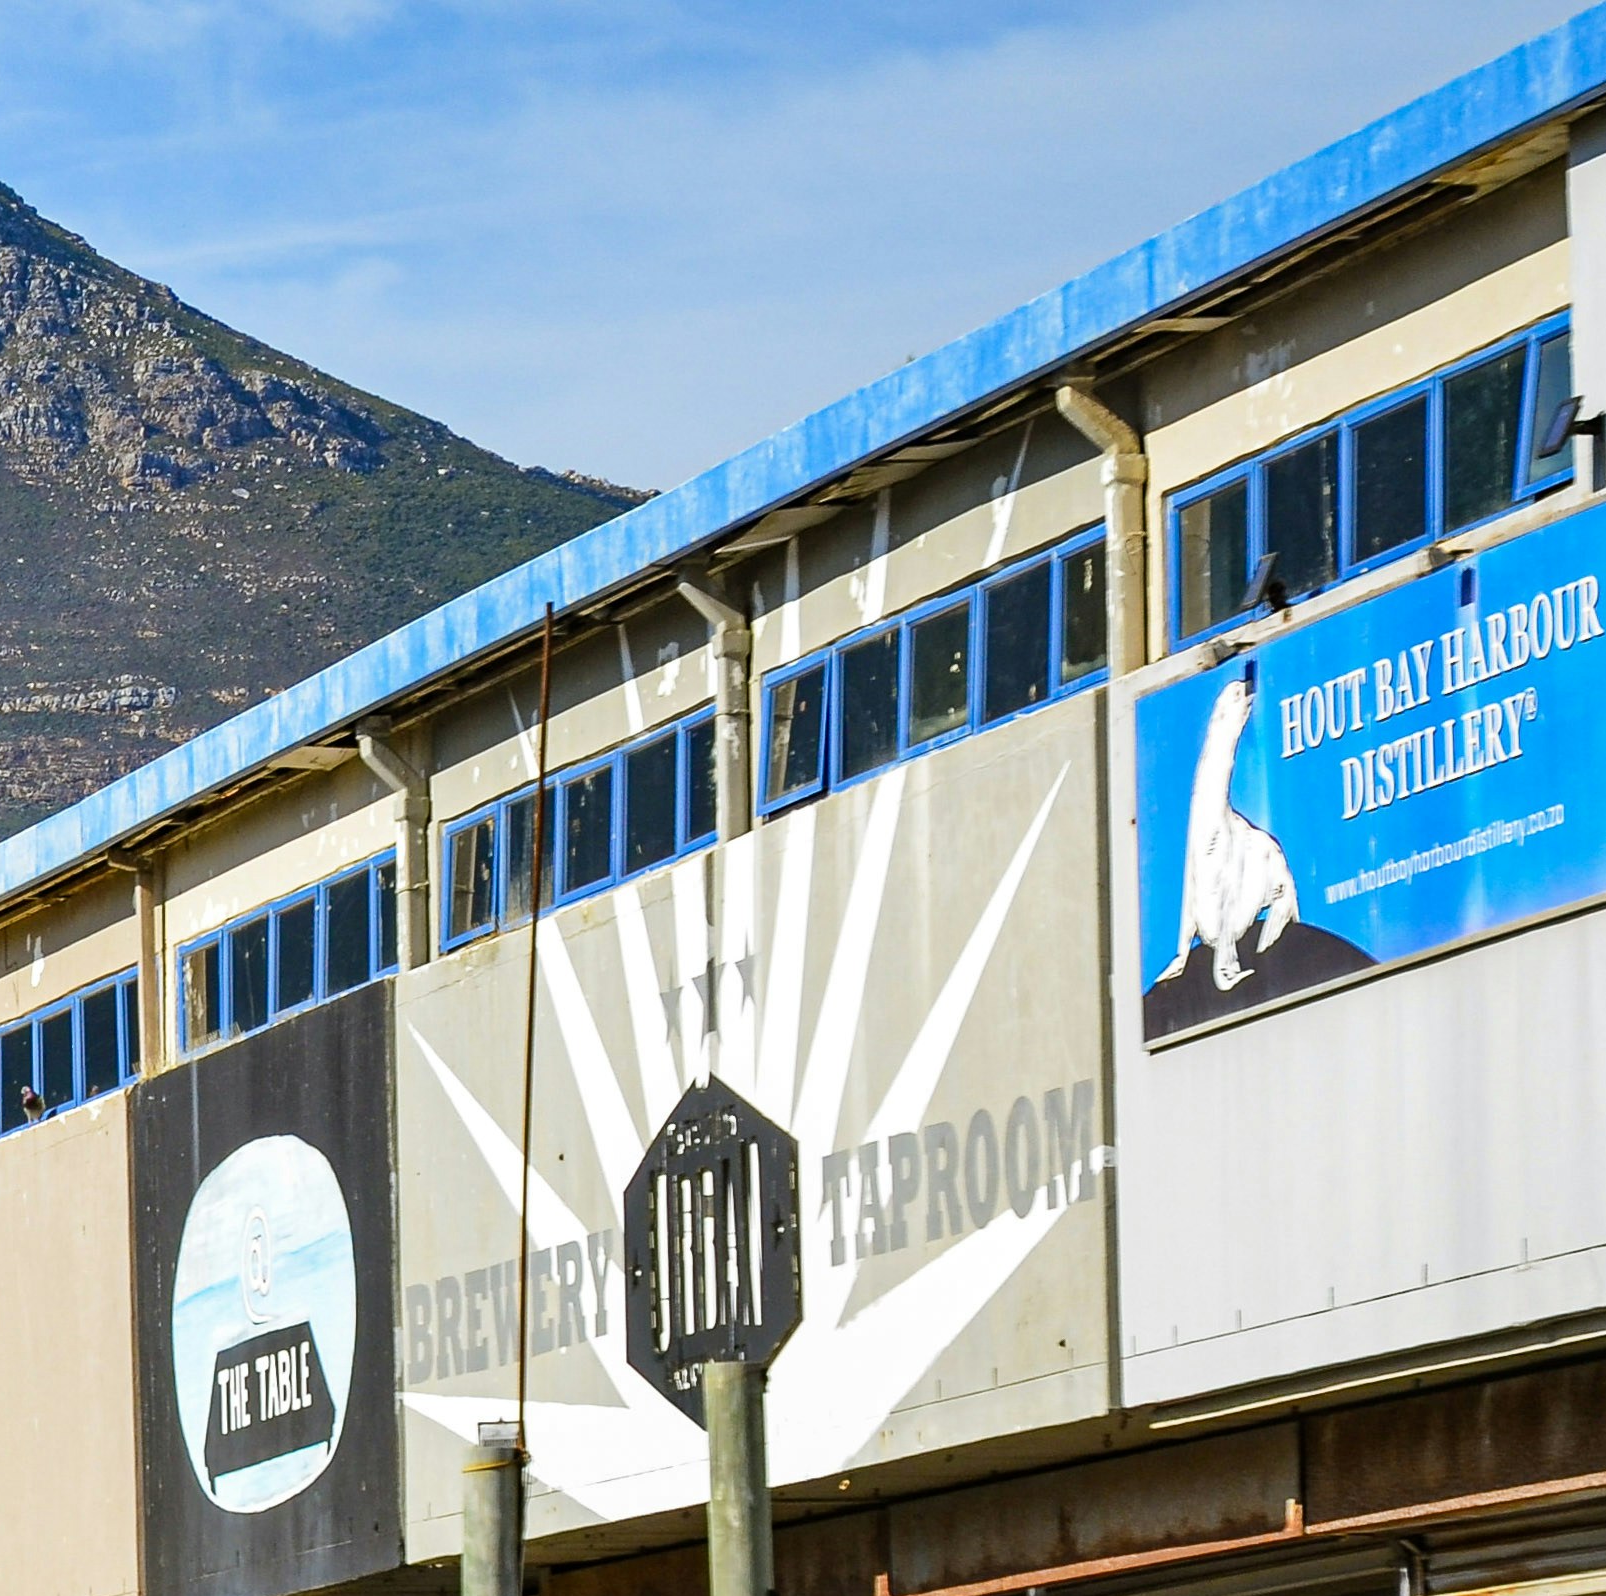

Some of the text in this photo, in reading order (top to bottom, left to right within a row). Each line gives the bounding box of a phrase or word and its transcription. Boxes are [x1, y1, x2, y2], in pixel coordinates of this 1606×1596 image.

[1279, 575, 1605, 758] HOUT BAY HARBOUR
[822, 1078, 1096, 1267] TAPROOM
[218, 1340, 312, 1436] THE TABLE
[406, 1228, 614, 1386] BREWERY
